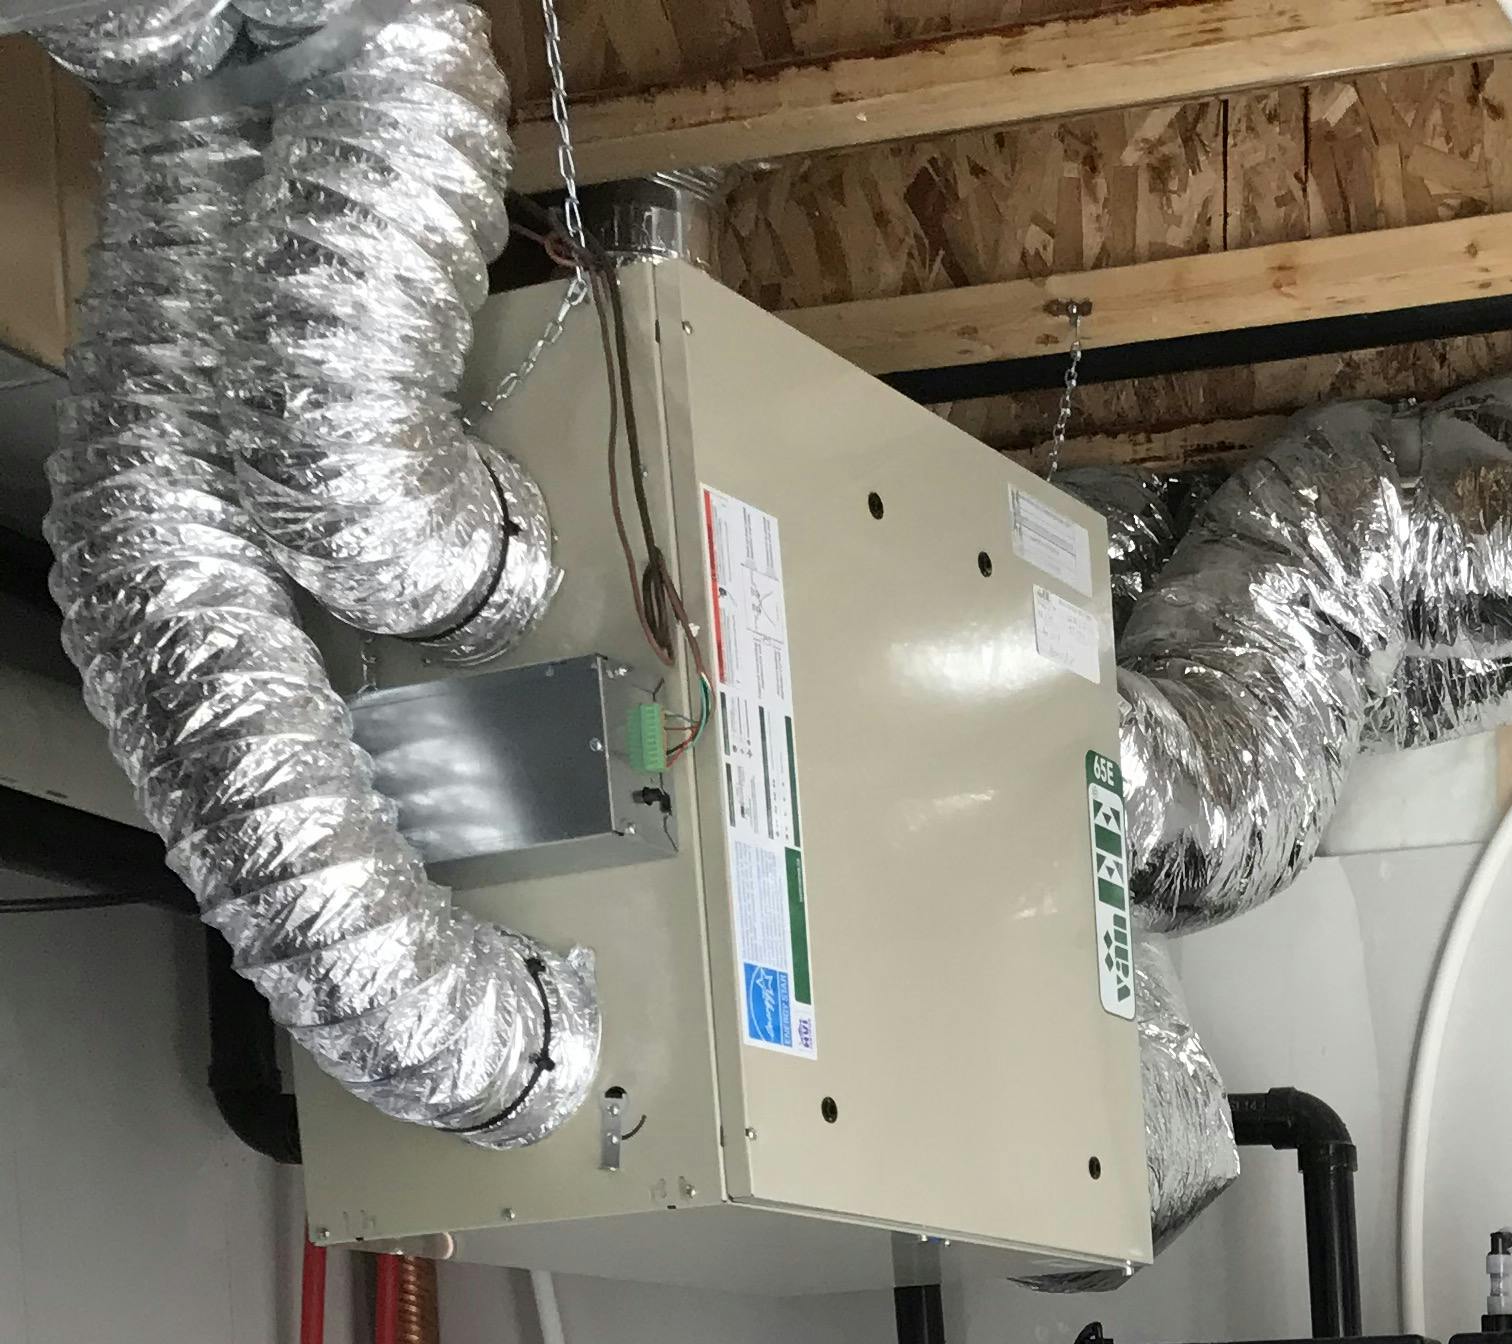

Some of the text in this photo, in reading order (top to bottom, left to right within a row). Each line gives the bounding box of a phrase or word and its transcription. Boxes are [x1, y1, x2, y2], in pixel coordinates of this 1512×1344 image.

[1092, 754, 1115, 786] 65E
[779, 974, 793, 1046] ENERGY STAR
